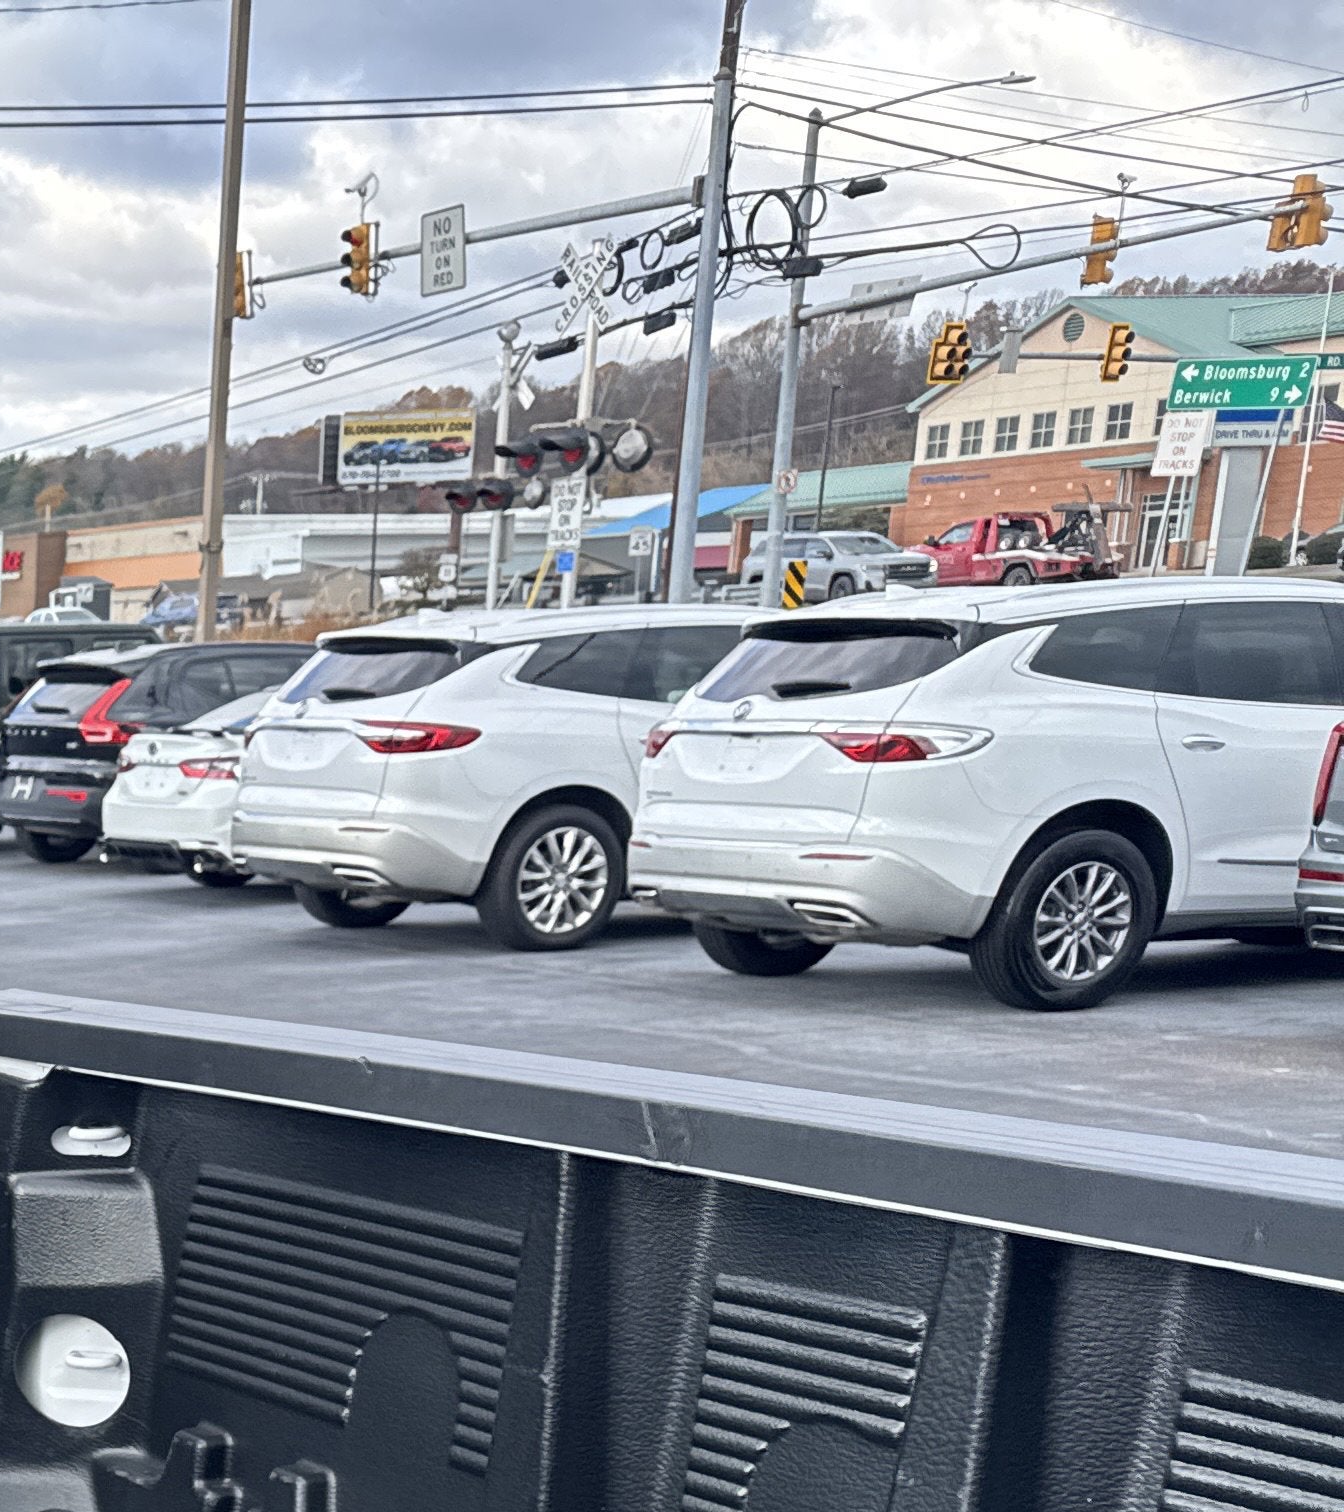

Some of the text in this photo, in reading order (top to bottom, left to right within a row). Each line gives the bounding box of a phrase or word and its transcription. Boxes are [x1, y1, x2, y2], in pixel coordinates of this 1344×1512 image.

[433, 216, 452, 237] NO
[430, 235, 456, 254] TURN
[435, 255, 451, 270] ON
[433, 271, 453, 287] RED
[555, 239, 614, 332] CROSSING
[1203, 362, 1310, 381] Bloomsburg 2
[1174, 387, 1280, 404] Berwick 9
[1184, 416, 1204, 428] NOT
[1169, 431, 1196, 442] STOP
[1216, 429, 1239, 440] DRIVE
[1241, 428, 1262, 438] THRU
[1172, 446, 1186, 456] ON
[1158, 460, 1195, 470] TRACKS
